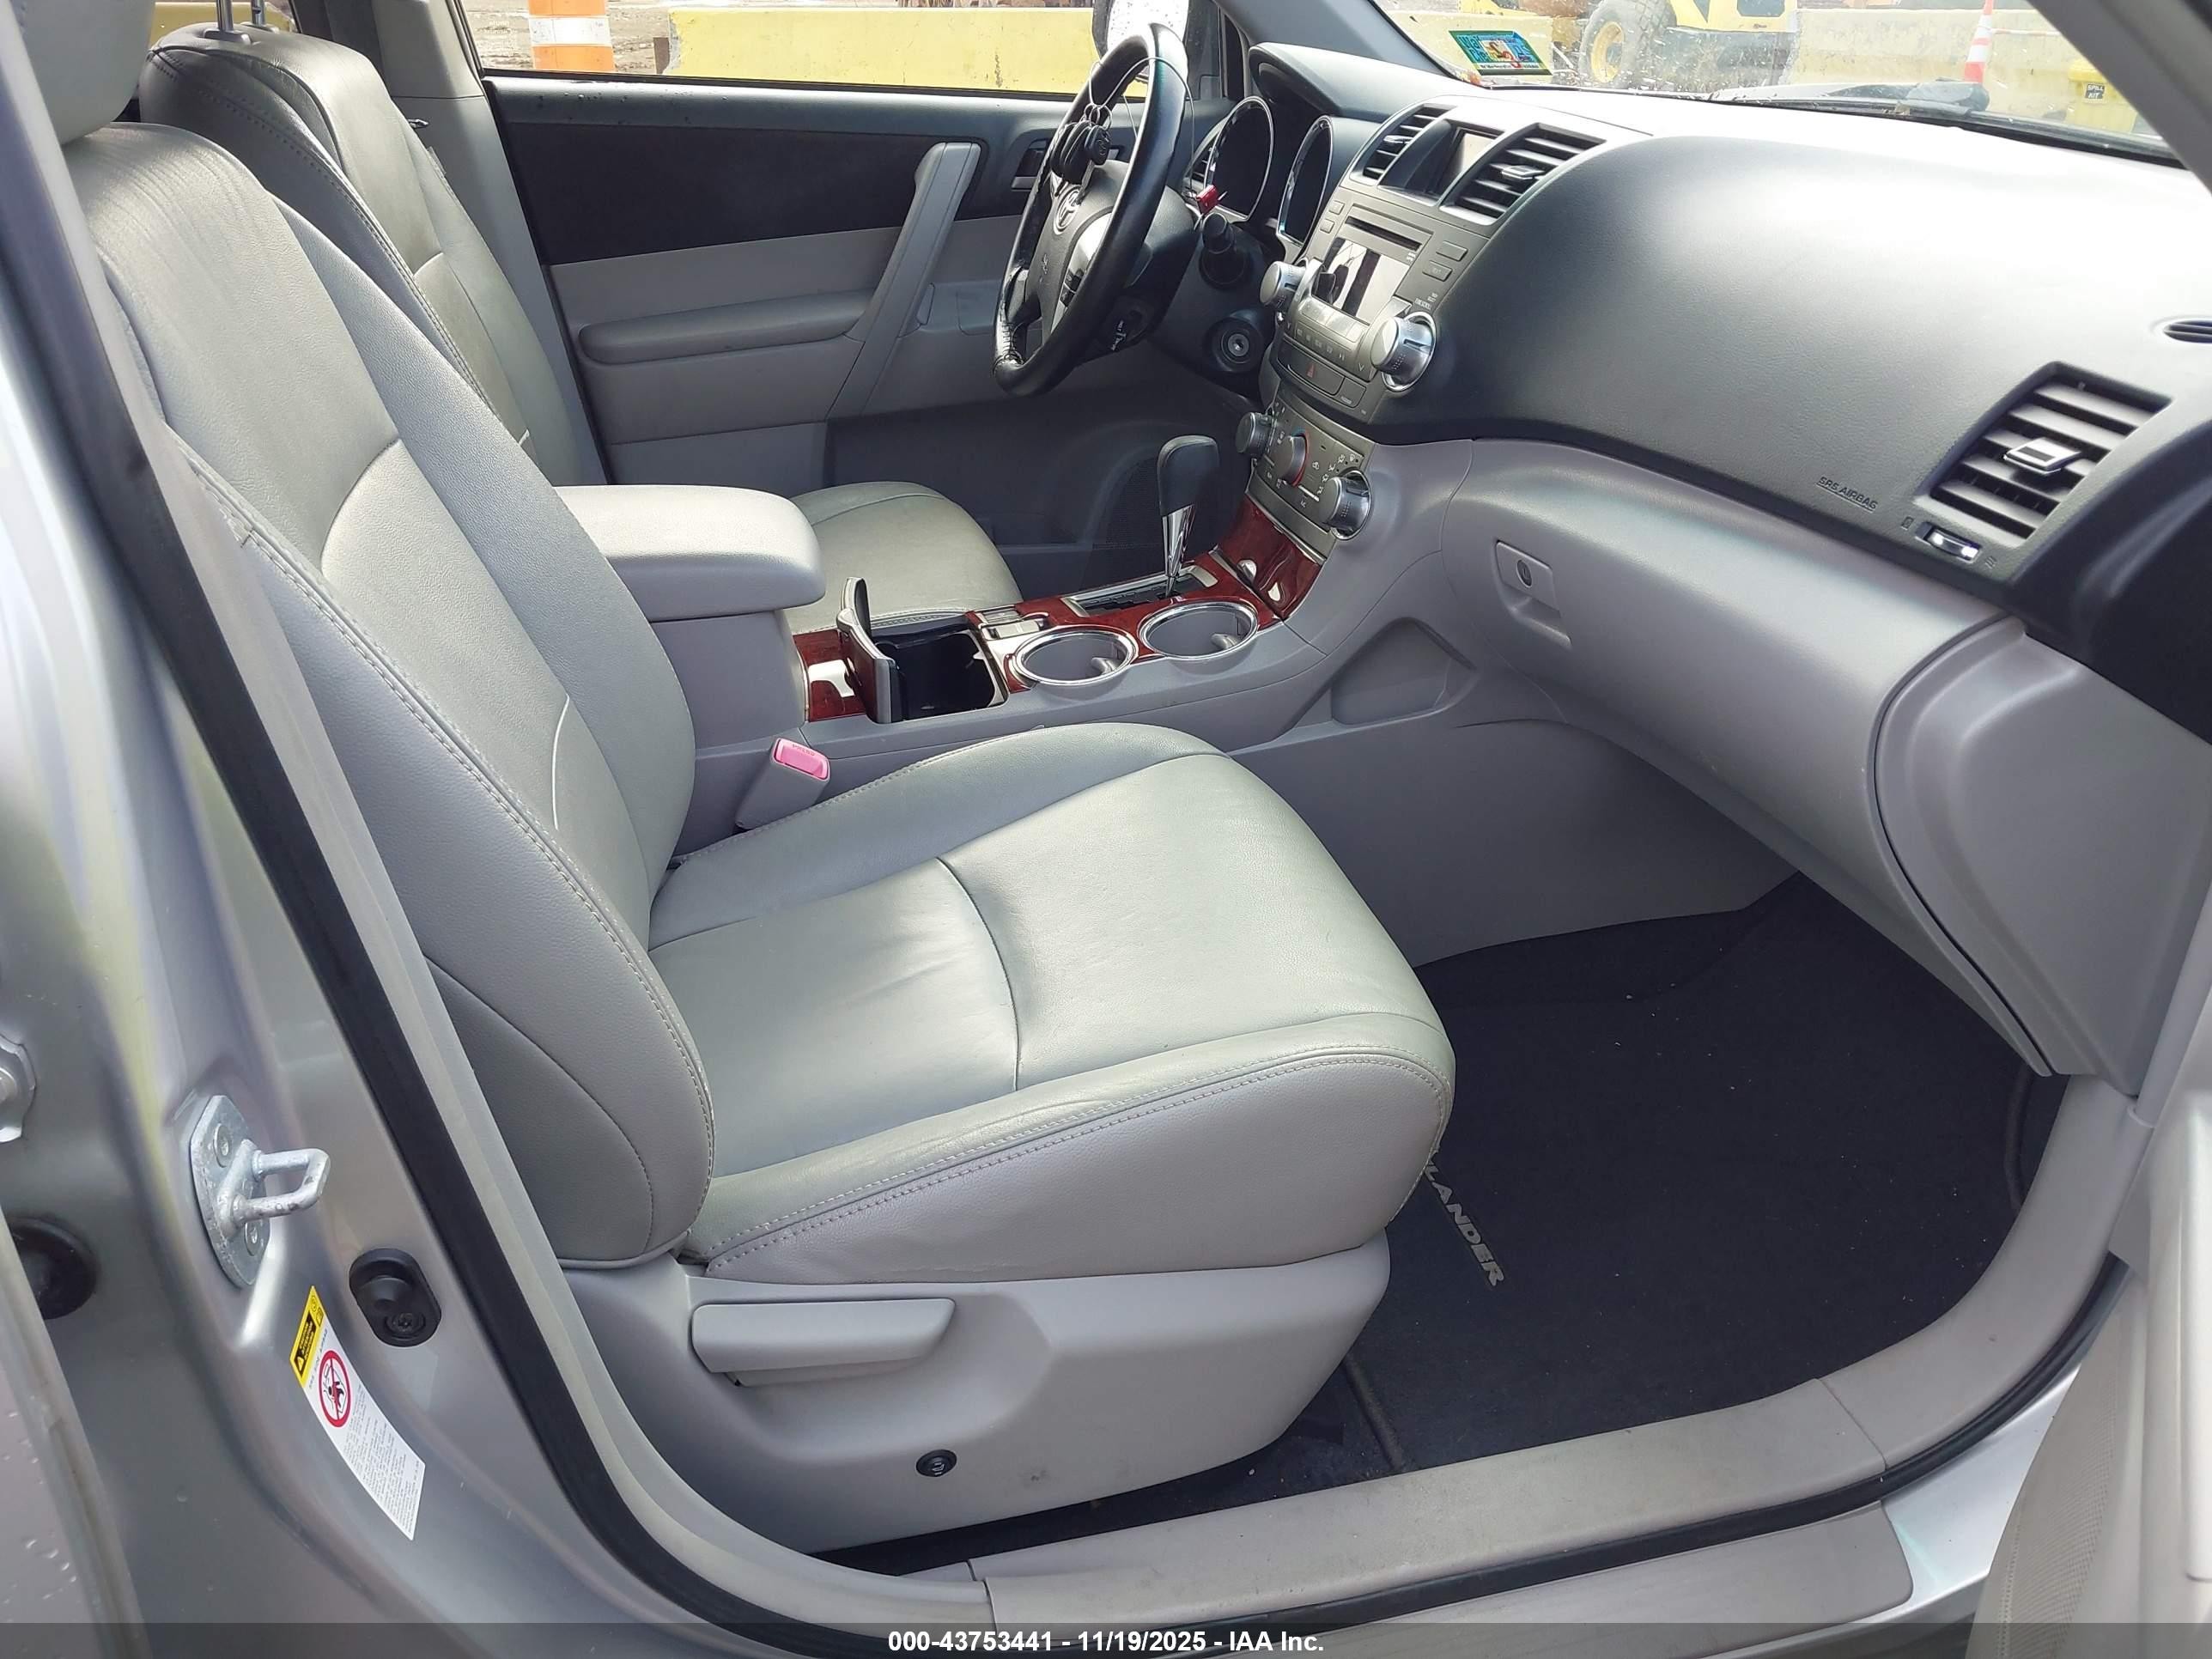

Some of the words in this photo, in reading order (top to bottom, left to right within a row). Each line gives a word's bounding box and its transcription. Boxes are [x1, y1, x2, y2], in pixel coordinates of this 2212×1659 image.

[1819, 476, 1839, 490] SRS
[1838, 486, 1879, 509] AIRBAG
[1424, 1159, 1504, 1286] LANDER
